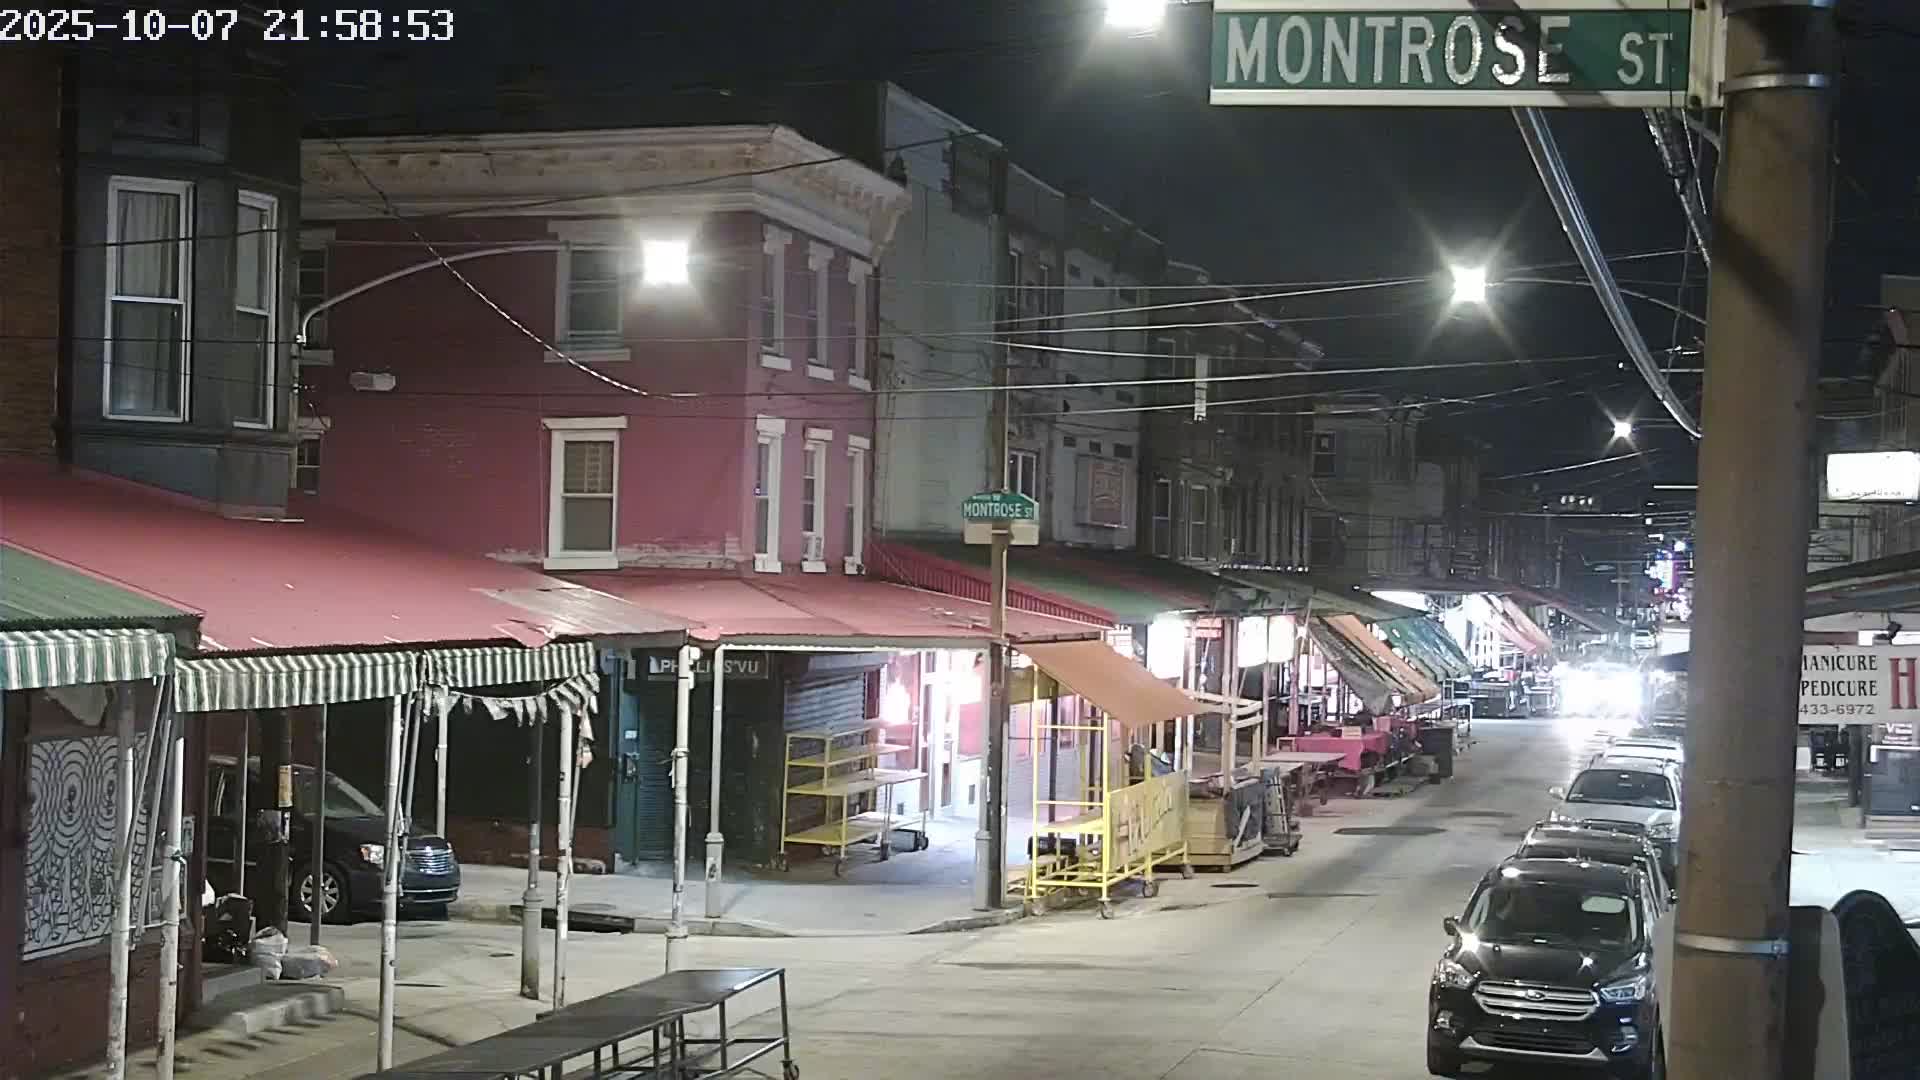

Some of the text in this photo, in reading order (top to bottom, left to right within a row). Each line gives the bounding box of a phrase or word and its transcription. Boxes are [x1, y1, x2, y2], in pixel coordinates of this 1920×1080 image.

[1225, 15, 1673, 86] MONTROSE ST
[963, 502, 1022, 518] MONTROSE
[1801, 680, 1878, 697] PEDICURE
